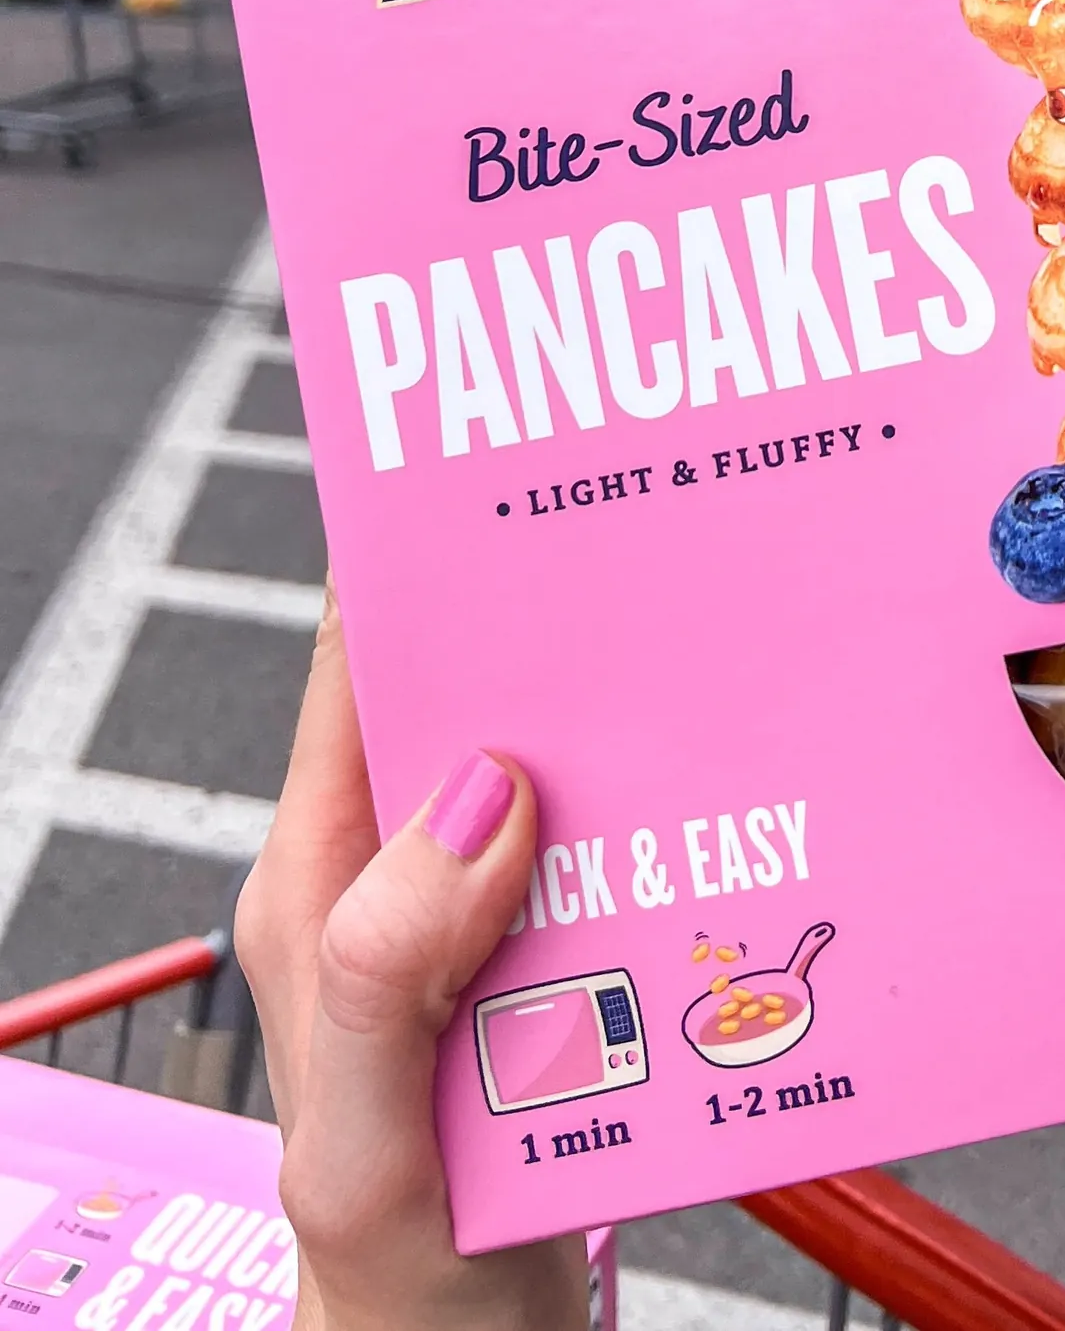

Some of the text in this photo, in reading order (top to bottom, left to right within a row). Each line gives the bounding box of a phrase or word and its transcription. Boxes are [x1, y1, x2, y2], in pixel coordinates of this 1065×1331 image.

[464, 69, 810, 203] Bite-Sized
[340, 155, 995, 472] PANCAKES
[529, 424, 863, 516] LIGHT & FLUFFY
[502, 800, 810, 936] ICK & EASY
[520, 1119, 632, 1164] 1 min
[705, 1073, 855, 1126] 1-2 min
